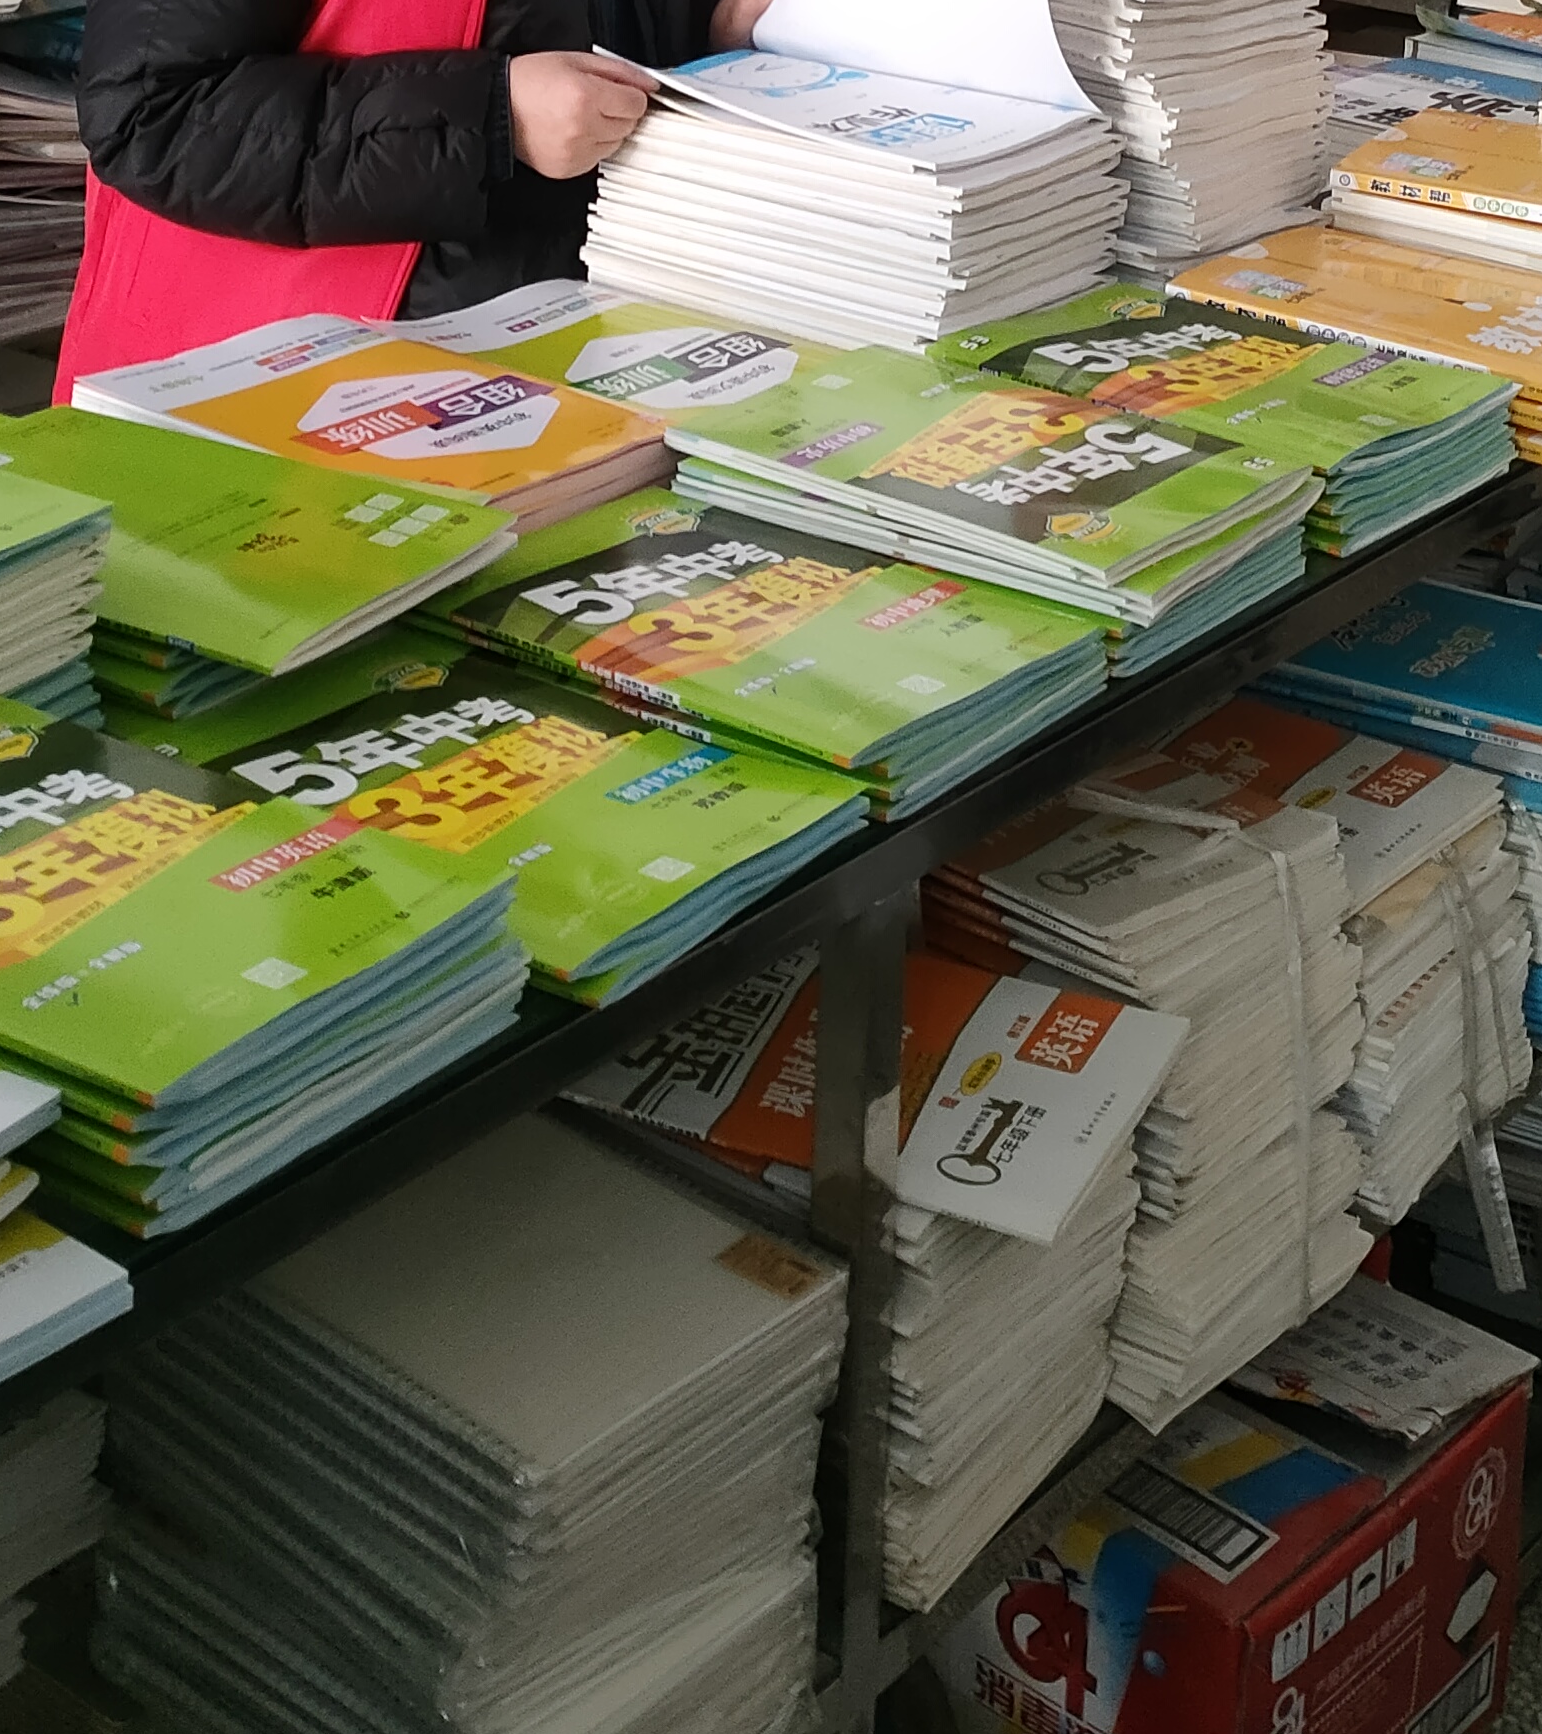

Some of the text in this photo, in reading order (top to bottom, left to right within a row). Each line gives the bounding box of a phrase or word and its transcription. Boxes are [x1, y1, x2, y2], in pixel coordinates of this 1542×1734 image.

[1369, 178, 1452, 204] 教材帮
[586, 353, 667, 401] 训练
[688, 332, 767, 371] 组合
[1032, 322, 1243, 374] 5年中考
[1127, 335, 1305, 394] 3年模拟
[317, 409, 415, 449] 训练
[436, 379, 526, 418] 组合
[955, 423, 1193, 507] 5年中考
[520, 539, 785, 625] 5年中考
[628, 556, 855, 654] 3年模拟
[231, 695, 536, 806] 5年中考
[349, 714, 608, 841] 3年模拟
[224, 828, 339, 889] 初中英语
[1029, 1009, 1101, 1071] 英语
[993, 1103, 1048, 1165] 七年级下册
